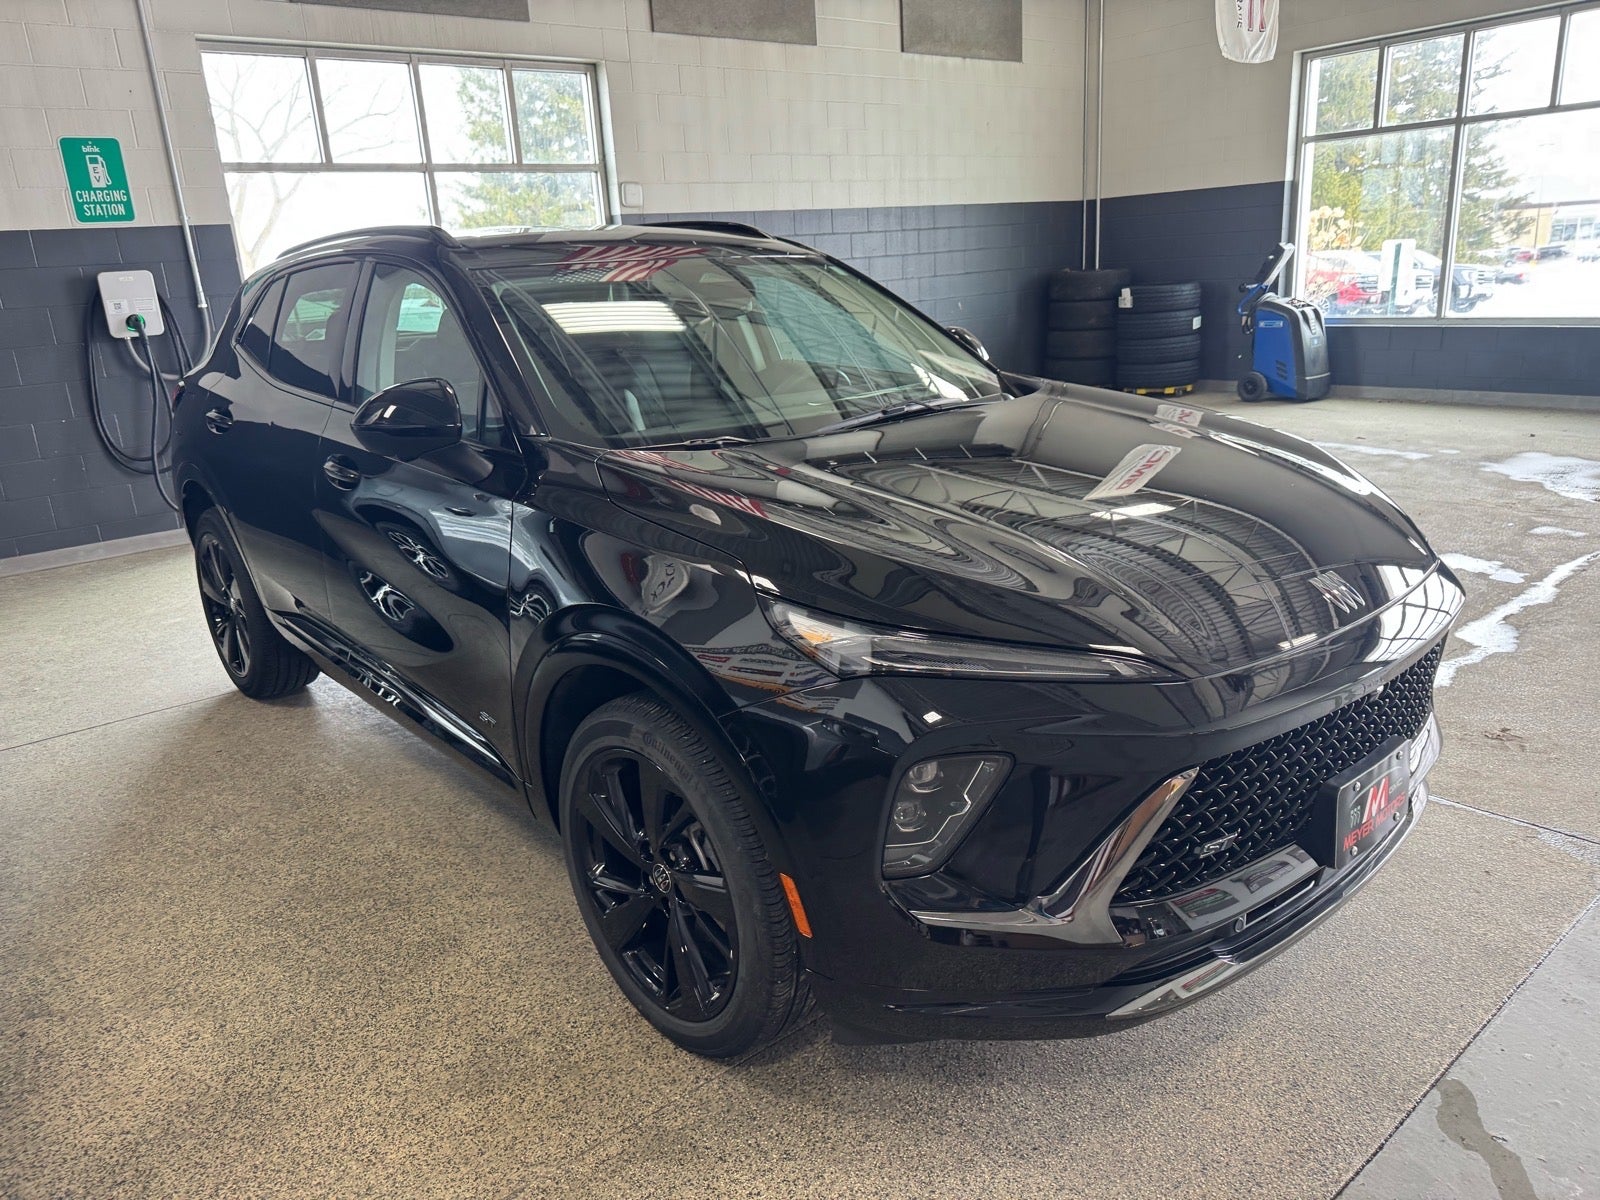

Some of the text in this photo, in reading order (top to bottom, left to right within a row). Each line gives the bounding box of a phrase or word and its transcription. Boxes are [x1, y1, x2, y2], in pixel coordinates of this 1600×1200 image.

[82, 143, 100, 153] blink
[75, 190, 128, 202] CHARGING
[83, 203, 126, 216] STATION
[1374, 790, 1407, 828] MOTORS
[1343, 820, 1375, 852] MEYER
